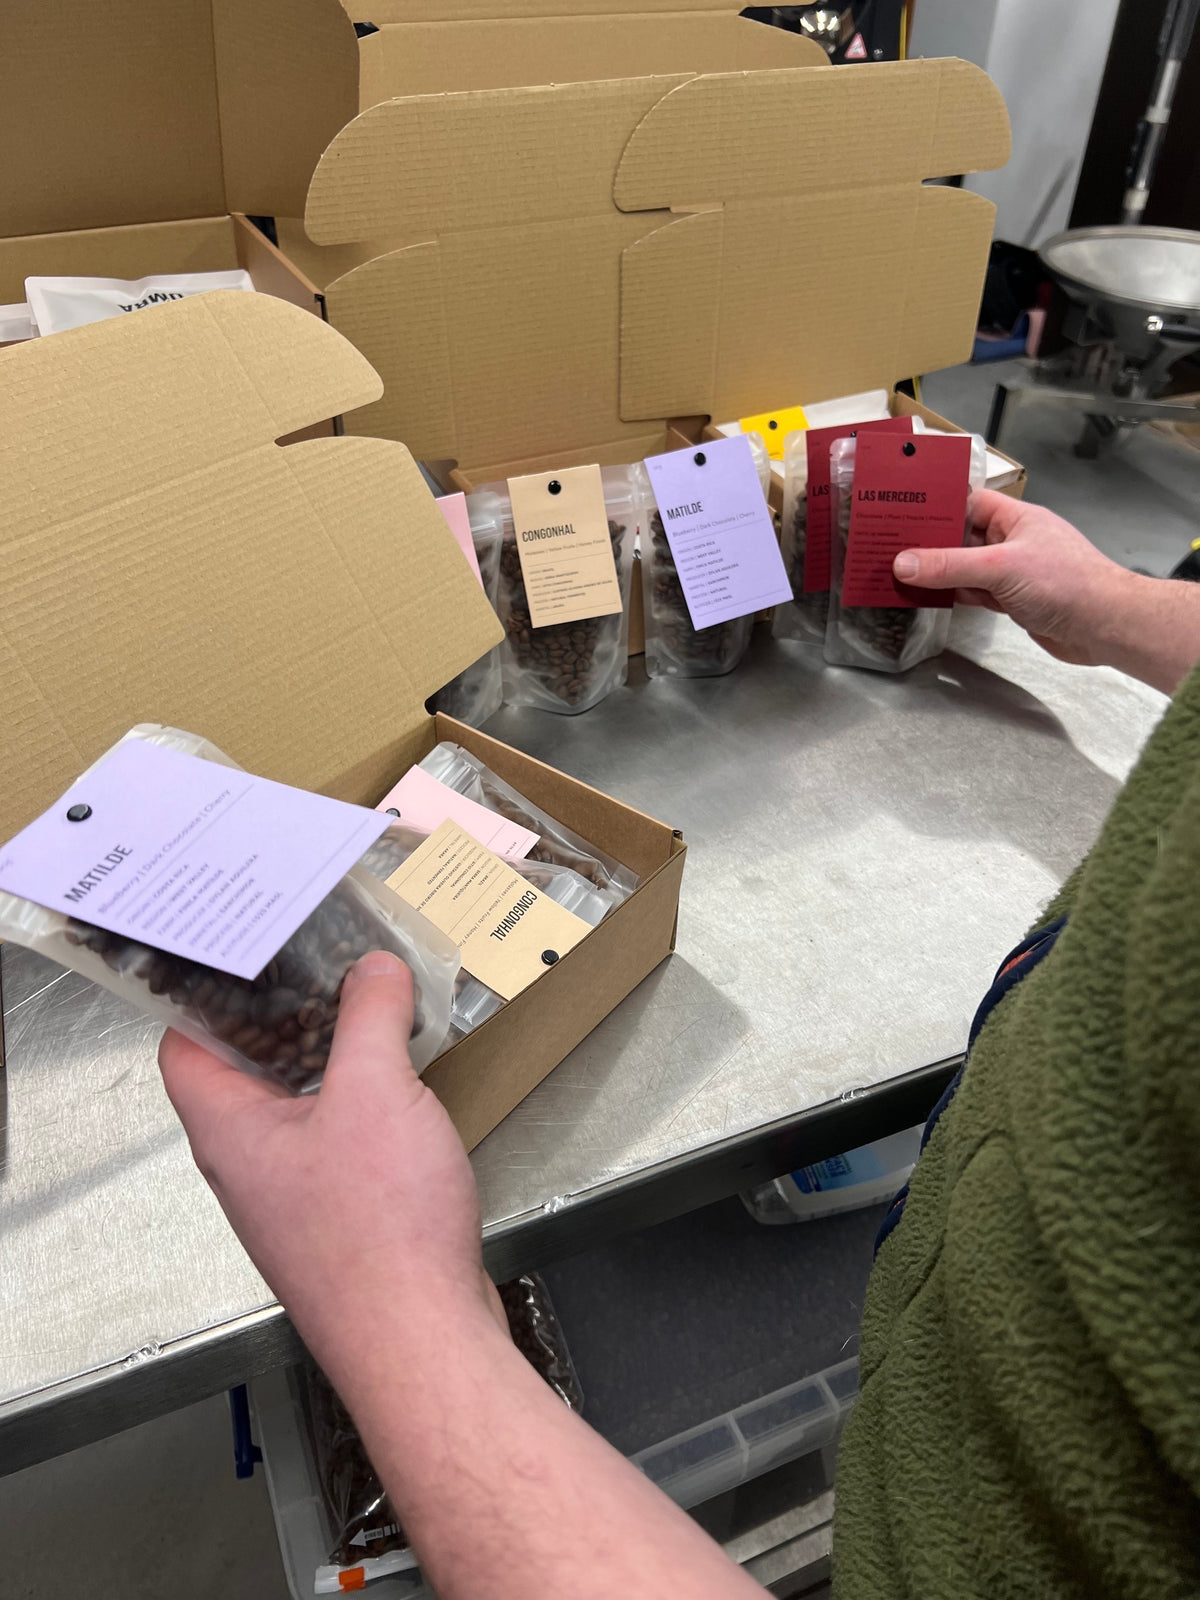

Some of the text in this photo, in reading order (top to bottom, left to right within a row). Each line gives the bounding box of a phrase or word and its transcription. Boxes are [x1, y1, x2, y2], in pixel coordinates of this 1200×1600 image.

[812, 485, 829, 497] LAS
[858, 490, 926, 504] LAS MERCEDES
[665, 501, 703, 520] MATILDE
[522, 524, 576, 542] CONGONHAL
[97, 876, 141, 913] Blueberry
[142, 852, 164, 869] Dark
[162, 816, 202, 852] Chocolate
[204, 789, 231, 812] Cherry
[64, 845, 133, 902] MATILDE
[500, 878, 518, 896] Molasses
[487, 898, 501, 912] Yellow
[476, 910, 490, 924] Fruits
[490, 890, 537, 941] CONGONHAL
[463, 925, 478, 940] Honey
